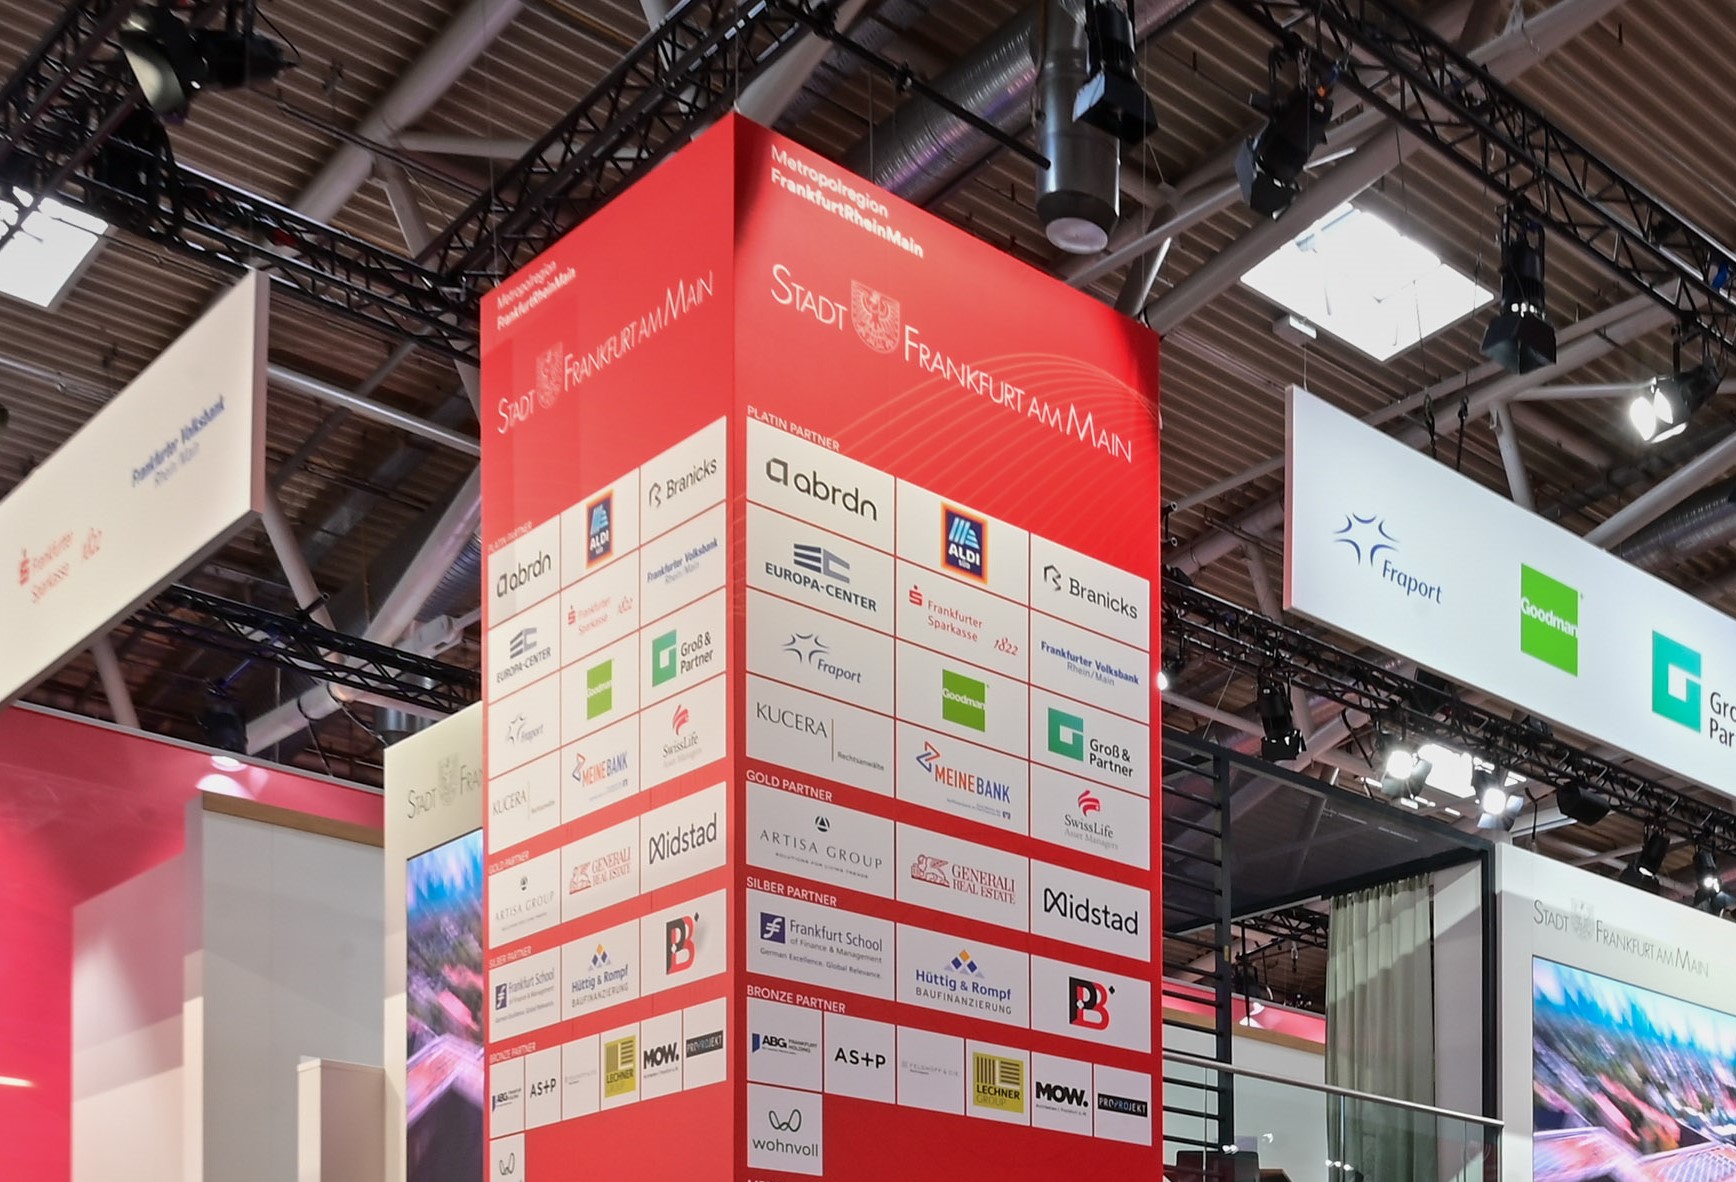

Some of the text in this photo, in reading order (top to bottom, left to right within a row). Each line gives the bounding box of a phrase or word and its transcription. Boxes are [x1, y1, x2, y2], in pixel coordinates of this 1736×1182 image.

[772, 145, 888, 218] Metropolregion
[772, 169, 923, 258] FrankfurtRheinMain
[498, 390, 535, 434] STADT
[564, 322, 635, 391] FRANKFURT
[665, 271, 713, 326] MAIN
[772, 264, 1131, 463] STADT FRANKFURT AM MAIN
[748, 405, 839, 451] PLATIN PARTNER
[666, 459, 716, 499] Branicks
[794, 471, 877, 521] abrdn
[590, 530, 609, 551] ALDI
[949, 543, 980, 565] ALDI
[509, 550, 551, 591] abrdn
[1382, 559, 1442, 604] Fraport
[765, 562, 876, 611] EUROPA-CENTER
[1069, 577, 1137, 619] Branicks
[928, 600, 982, 629] Frankfurter
[1521, 596, 1578, 638] Goodman
[681, 632, 711, 656] Groß &
[928, 616, 1019, 656] Sparkasse 1822
[681, 649, 713, 674] Partner
[818, 659, 861, 683] Fraport
[1041, 641, 1139, 684] Frankfurter Volksbank
[1067, 662, 1115, 686] Rhein/Main
[943, 688, 985, 710] Goodman
[756, 702, 827, 738] KUCERA
[1710, 718, 1736, 748] Par
[1090, 738, 1130, 762] Groß &
[1090, 753, 1133, 777] Partner
[746, 770, 832, 802] GOLD PARTNER
[1064, 814, 1113, 839] SwissLife
[592, 847, 631, 873] GENERALI
[760, 830, 882, 869] ARTISA GROUP
[747, 877, 837, 906] SILBER PARTNER
[952, 865, 1015, 892] GENERALI
[953, 879, 1015, 905] REAL ESTATE
[790, 920, 882, 952] Frankfurt School
[1534, 899, 1569, 932] STADT
[1596, 920, 1653, 959] FRANKFURT
[916, 969, 1011, 1000] Hüttig & Rompf
[747, 985, 845, 1013] BRONZE PARTNER
[916, 987, 1012, 1015] BAUFINANZIERUNG
[644, 1042, 679, 1069] MOW.
[762, 1035, 787, 1048] ABG
[835, 1048, 885, 1069] AS+P
[530, 1078, 556, 1098] AS+P
[977, 1085, 1020, 1100] LECHNER
[1036, 1081, 1088, 1107] MOW.
[1099, 1098, 1145, 1113] PROPROJEKT
[753, 1138, 818, 1157] wohnvoll
